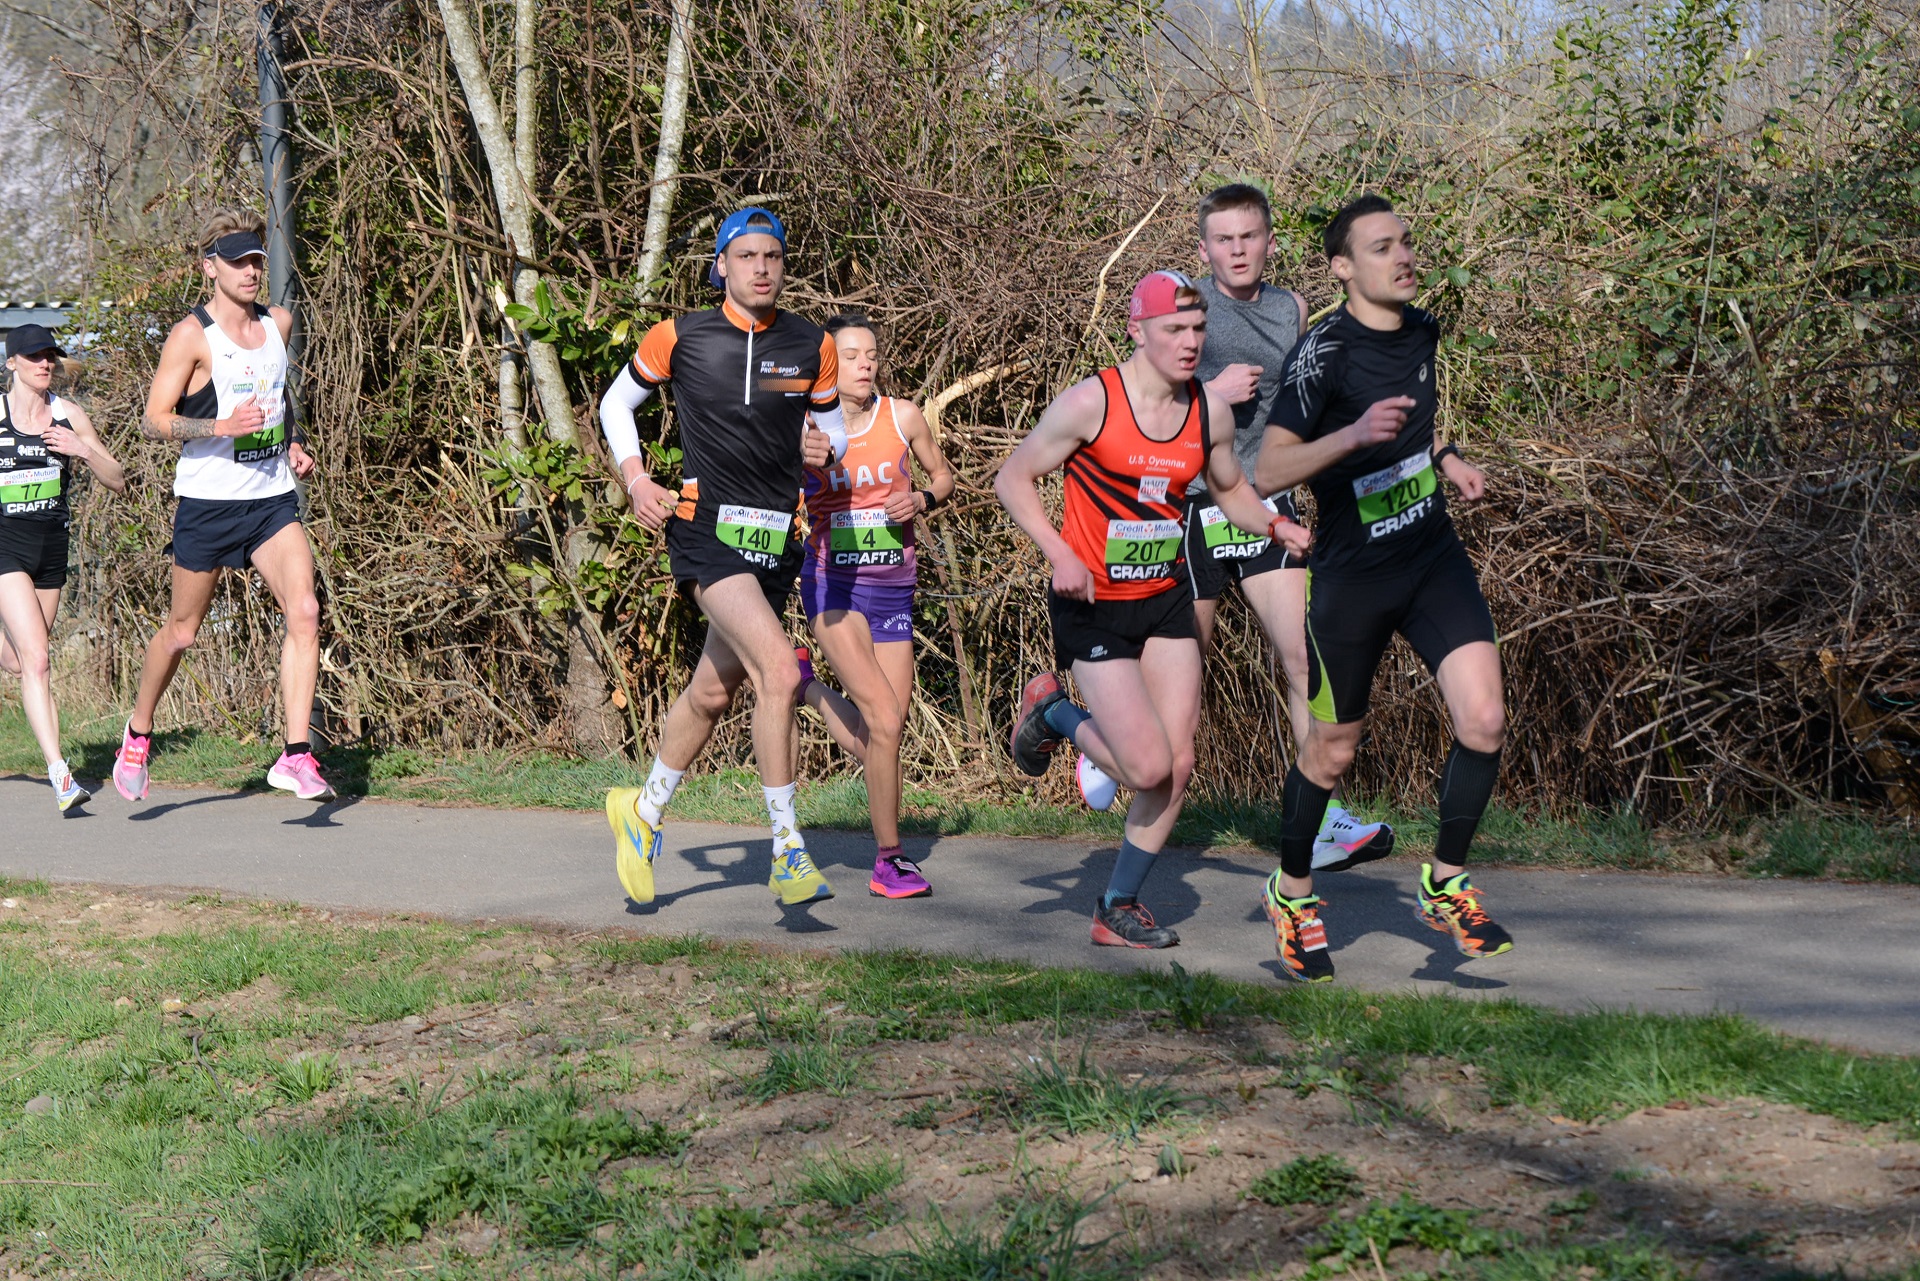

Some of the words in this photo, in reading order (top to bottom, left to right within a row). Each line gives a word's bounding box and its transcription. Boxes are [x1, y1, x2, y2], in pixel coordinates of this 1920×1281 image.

[257, 428, 274, 446] 74
[238, 446, 278, 461] CRAFT
[1128, 455, 1146, 464] U.S.
[1149, 456, 1186, 468] Oyonnax
[34, 469, 57, 478] Mutuel
[830, 462, 893, 492] HAC
[21, 483, 42, 500] 77
[1380, 478, 1420, 513] 120
[6, 500, 48, 514] CRAFT
[836, 512, 862, 521] Crédit
[873, 512, 890, 520] Mut
[1370, 501, 1425, 538] CRAFT
[1116, 523, 1143, 532] Crédit
[1223, 522, 1260, 541] 14
[734, 526, 770, 550] 140
[862, 528, 876, 548] 4
[738, 550, 768, 566] AFT
[1124, 540, 1166, 562] 207
[1213, 541, 1264, 559] CRAFT
[836, 552, 888, 565] CRAFT
[1110, 564, 1162, 579] CRAFT
[898, 622, 908, 630] AC
